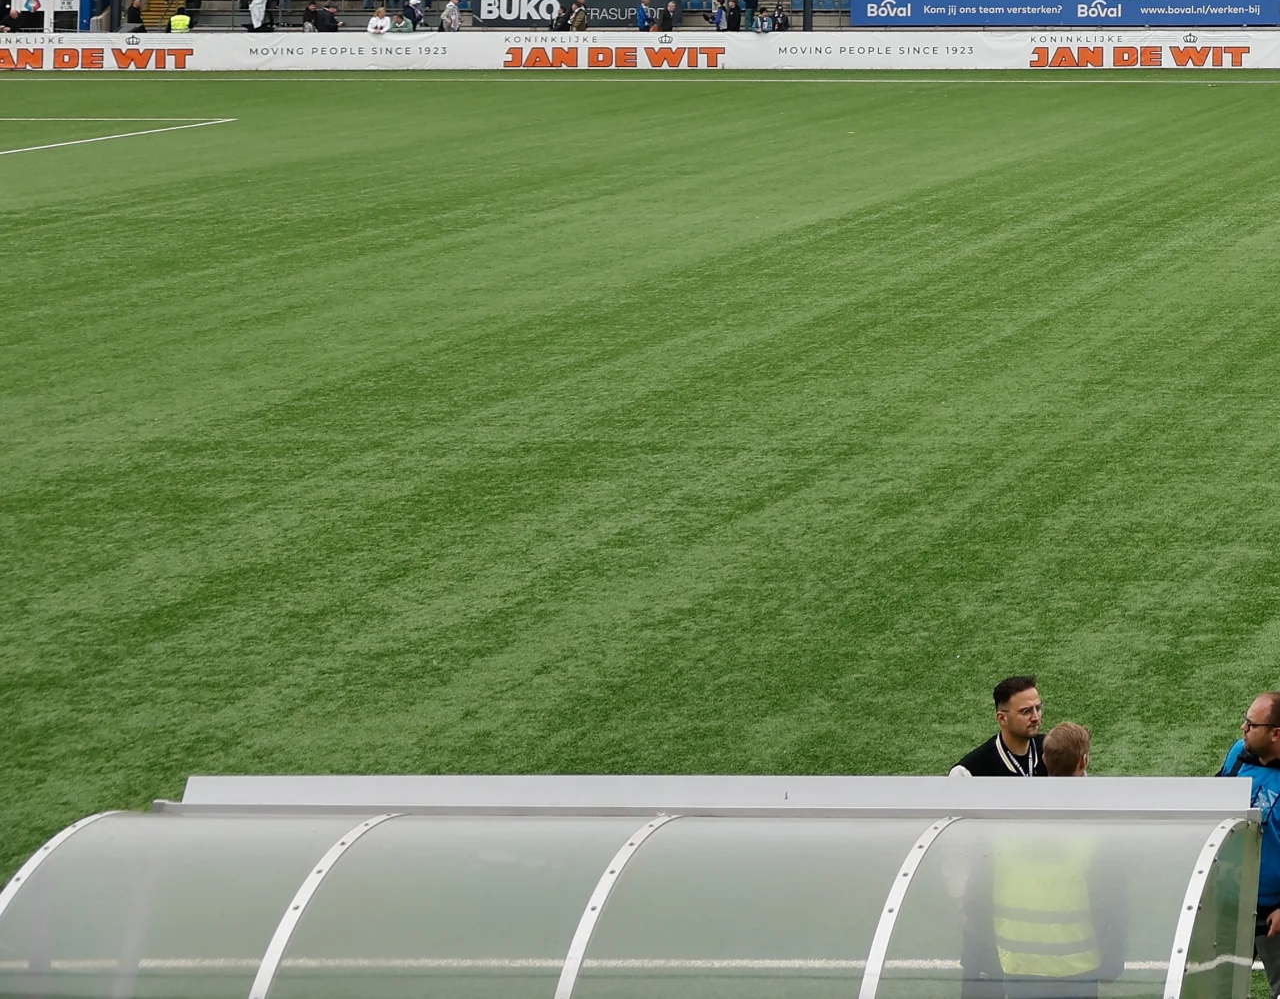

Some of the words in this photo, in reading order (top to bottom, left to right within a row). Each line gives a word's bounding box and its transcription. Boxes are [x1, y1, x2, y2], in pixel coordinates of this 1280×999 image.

[923, 5, 946, 14] Kom
[948, 5, 957, 16] jij
[959, 6, 977, 14] ons
[979, 5, 1004, 14] team
[1007, 5, 1063, 14] versterken?
[1140, 5, 1260, 16] www.boval.nl/werken-bij
[1030, 35, 1124, 43] KONINKLIJKE
[249, 47, 304, 56] MOVING
[311, 47, 365, 56] PEOPLE
[371, 47, 411, 56] SINCE
[418, 47, 448, 56] 1923
[1030, 46, 1103, 67] JAN
[1113, 46, 1162, 67] DE
[1169, 46, 1251, 67] WIT
